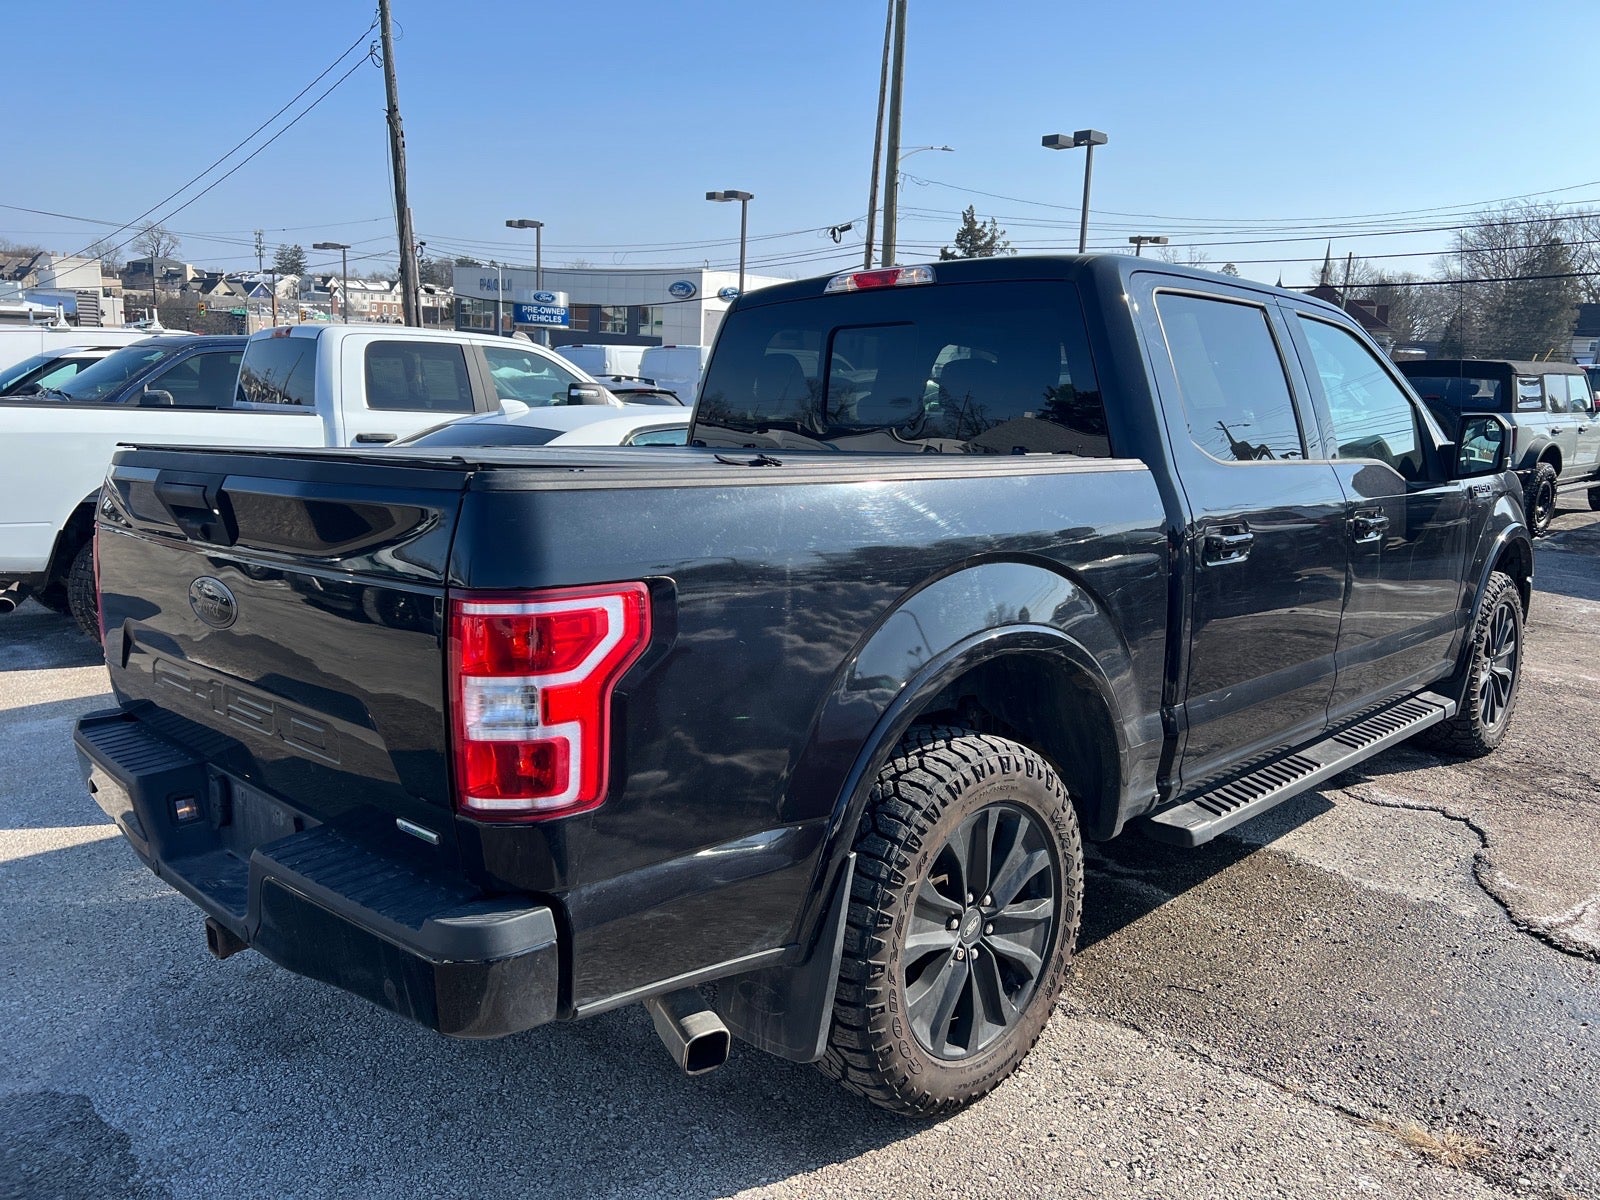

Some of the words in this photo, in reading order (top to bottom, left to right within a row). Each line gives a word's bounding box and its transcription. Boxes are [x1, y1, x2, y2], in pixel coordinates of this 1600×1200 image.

[480, 278, 512, 292] PAOLI
[522, 305, 566, 316] PRE-OWNED
[526, 314, 562, 323] VEHICLES
[888, 850, 929, 1076] GOODYEAR
